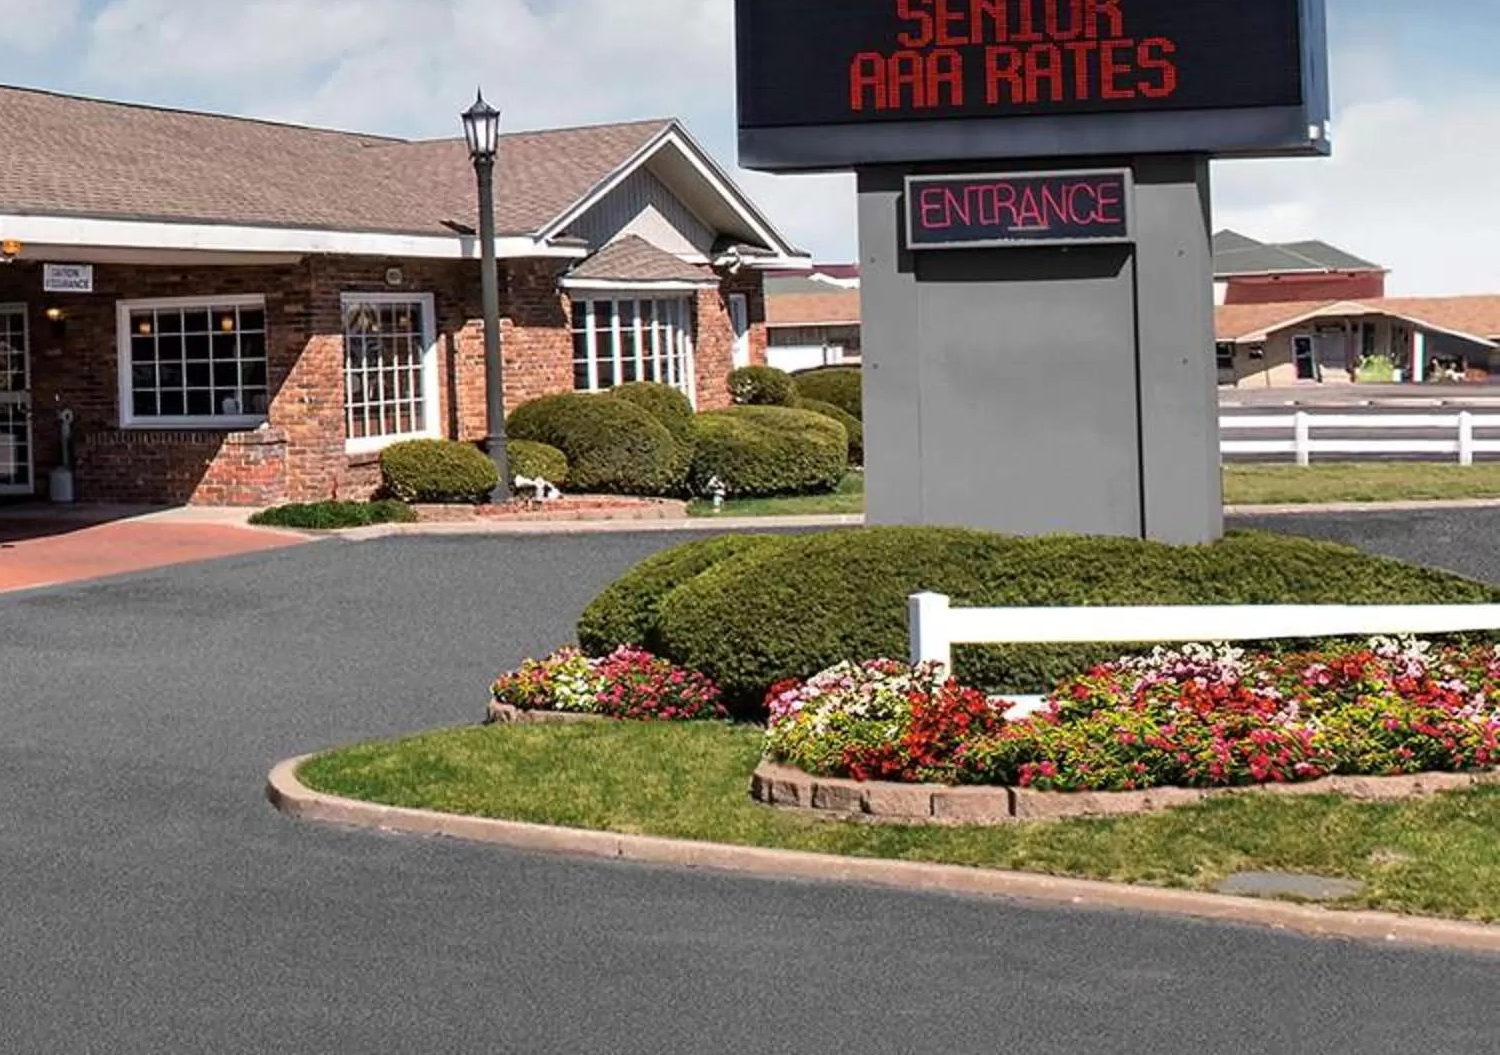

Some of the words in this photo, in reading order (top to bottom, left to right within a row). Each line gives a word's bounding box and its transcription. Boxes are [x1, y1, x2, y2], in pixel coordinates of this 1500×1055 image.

[850, 50, 962, 109] AAA
[986, 38, 1177, 104] RATES
[920, 183, 1121, 229] ENTRANCE
